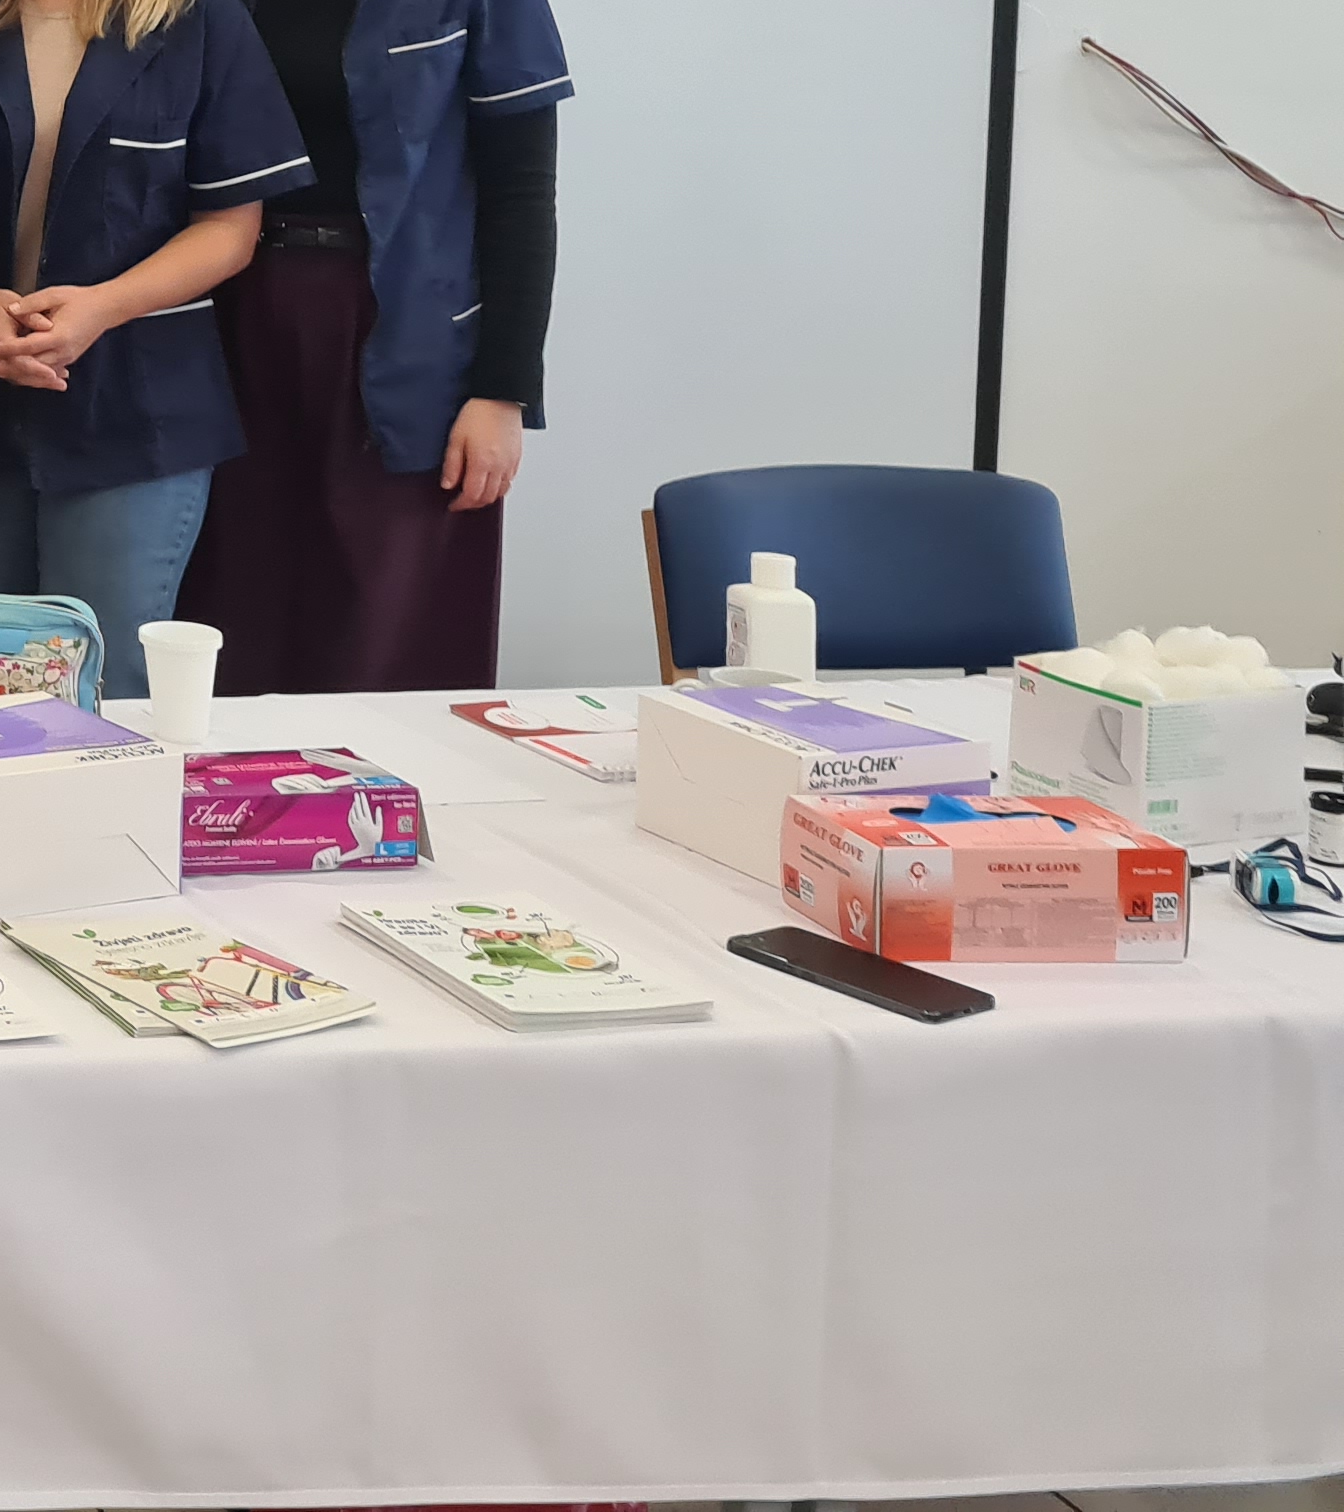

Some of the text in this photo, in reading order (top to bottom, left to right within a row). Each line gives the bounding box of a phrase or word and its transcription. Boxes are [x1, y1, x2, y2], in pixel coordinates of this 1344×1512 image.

[809, 755, 898, 778] ACCU-CHEK
[188, 799, 252, 827] Ebruli
[793, 811, 828, 841] GREAT
[828, 832, 865, 863] GLOVE
[1154, 896, 1178, 910] 200
